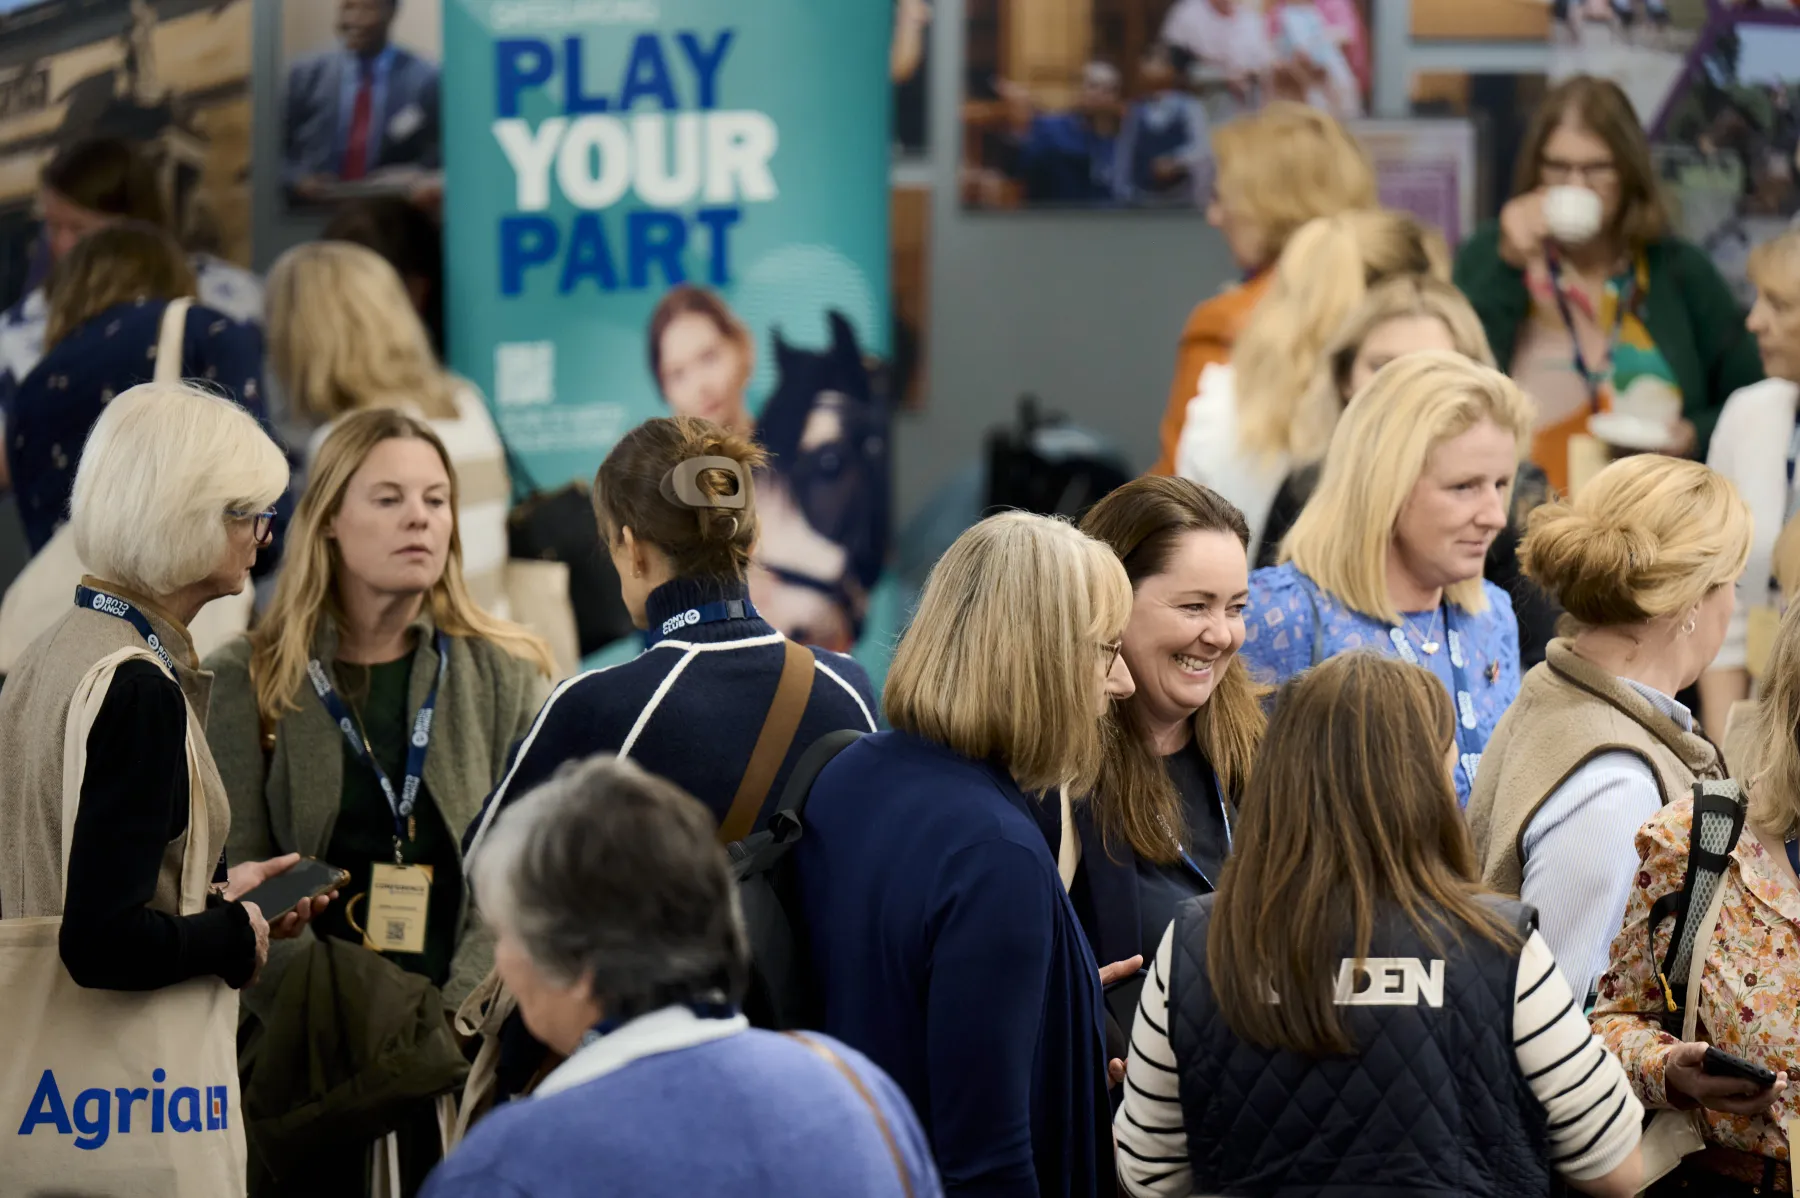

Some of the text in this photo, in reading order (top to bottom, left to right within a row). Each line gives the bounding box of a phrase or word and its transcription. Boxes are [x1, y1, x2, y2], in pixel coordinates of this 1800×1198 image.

[494, 29, 736, 118] PLAY
[491, 109, 779, 212] YOUR
[497, 208, 741, 296] PART
[102, 604, 126, 616] PONY
[105, 596, 129, 611] CLUB
[663, 612, 684, 628] PONY
[663, 619, 685, 635] CLUB
[17, 1067, 203, 1150] Agria
